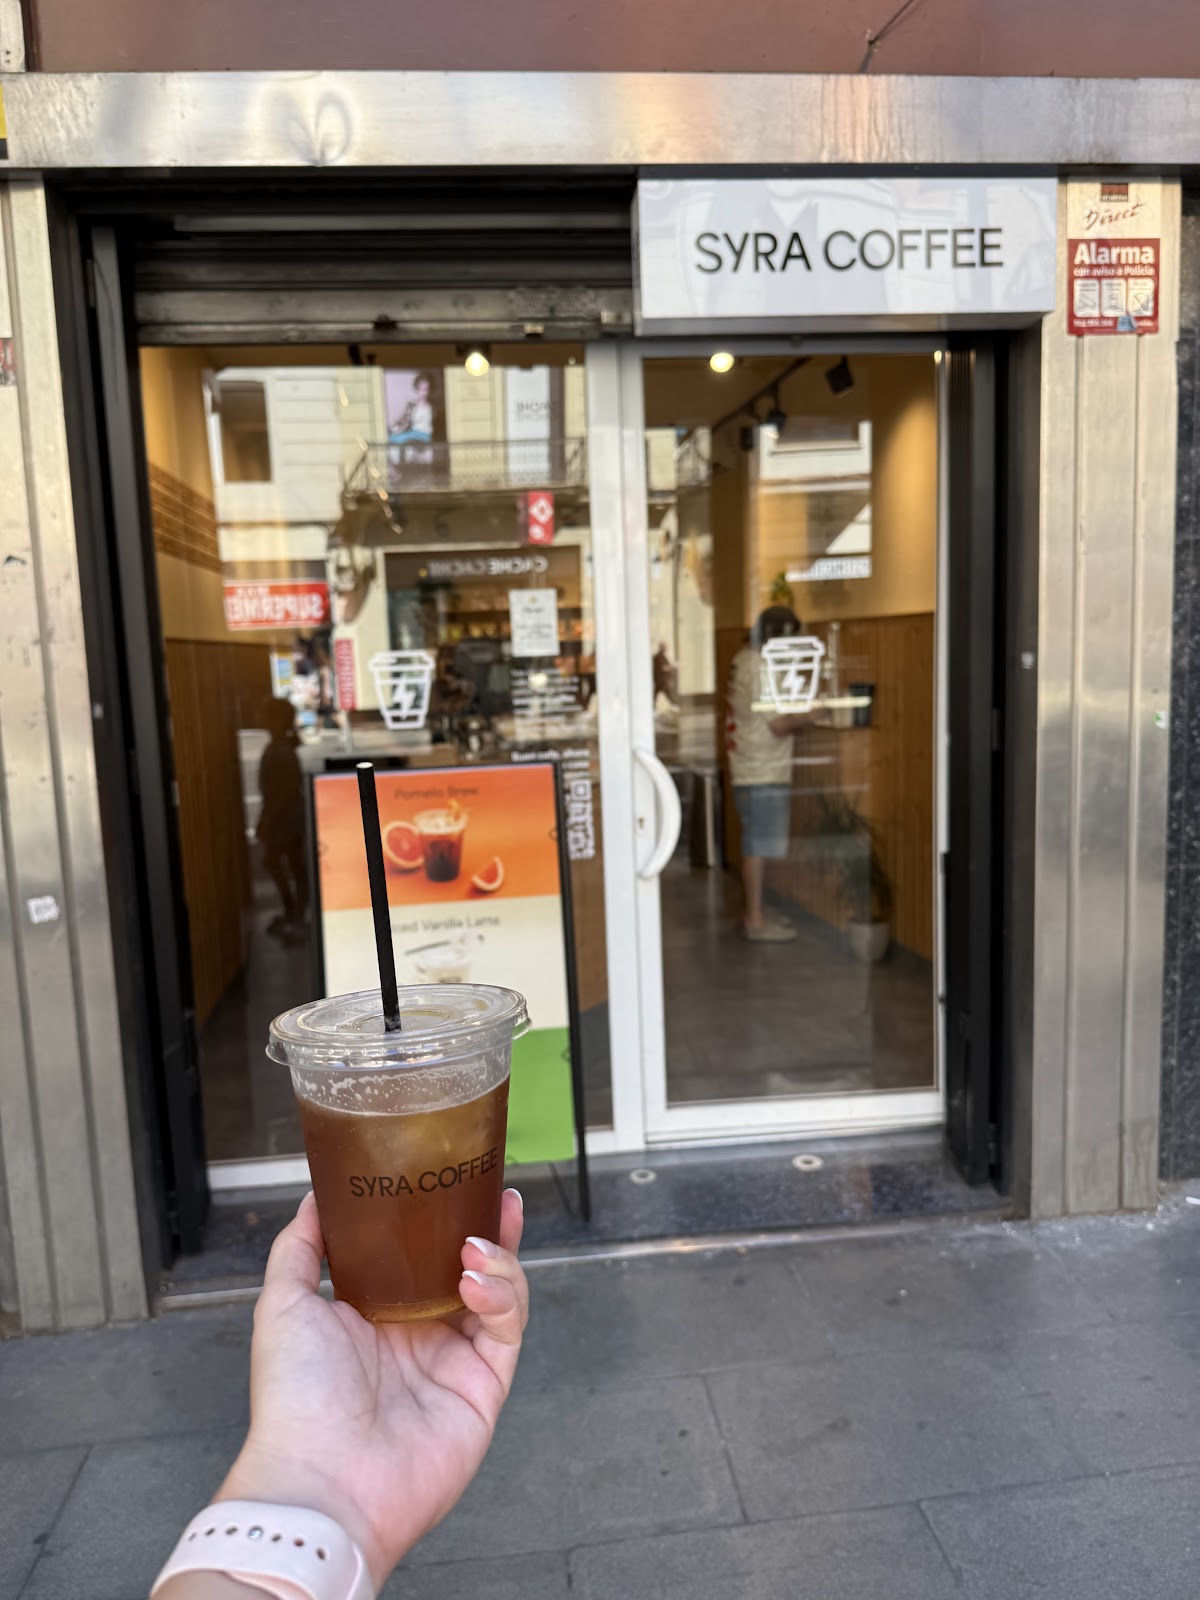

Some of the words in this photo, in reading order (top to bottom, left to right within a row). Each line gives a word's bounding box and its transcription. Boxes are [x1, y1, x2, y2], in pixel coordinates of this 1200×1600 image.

[1085, 202, 1148, 230] Direct
[695, 231, 812, 274] SYRA
[823, 228, 1004, 271] COFFEE
[1073, 243, 1156, 265] Alarma
[1116, 266, 1124, 276] a
[394, 787, 444, 800] Pomelo
[447, 785, 479, 798] Brew
[391, 919, 419, 933] ced
[420, 917, 464, 931] Vanilla
[465, 915, 501, 928] Latte
[348, 1174, 414, 1198] SYRA
[418, 1146, 498, 1193] COFFEE
